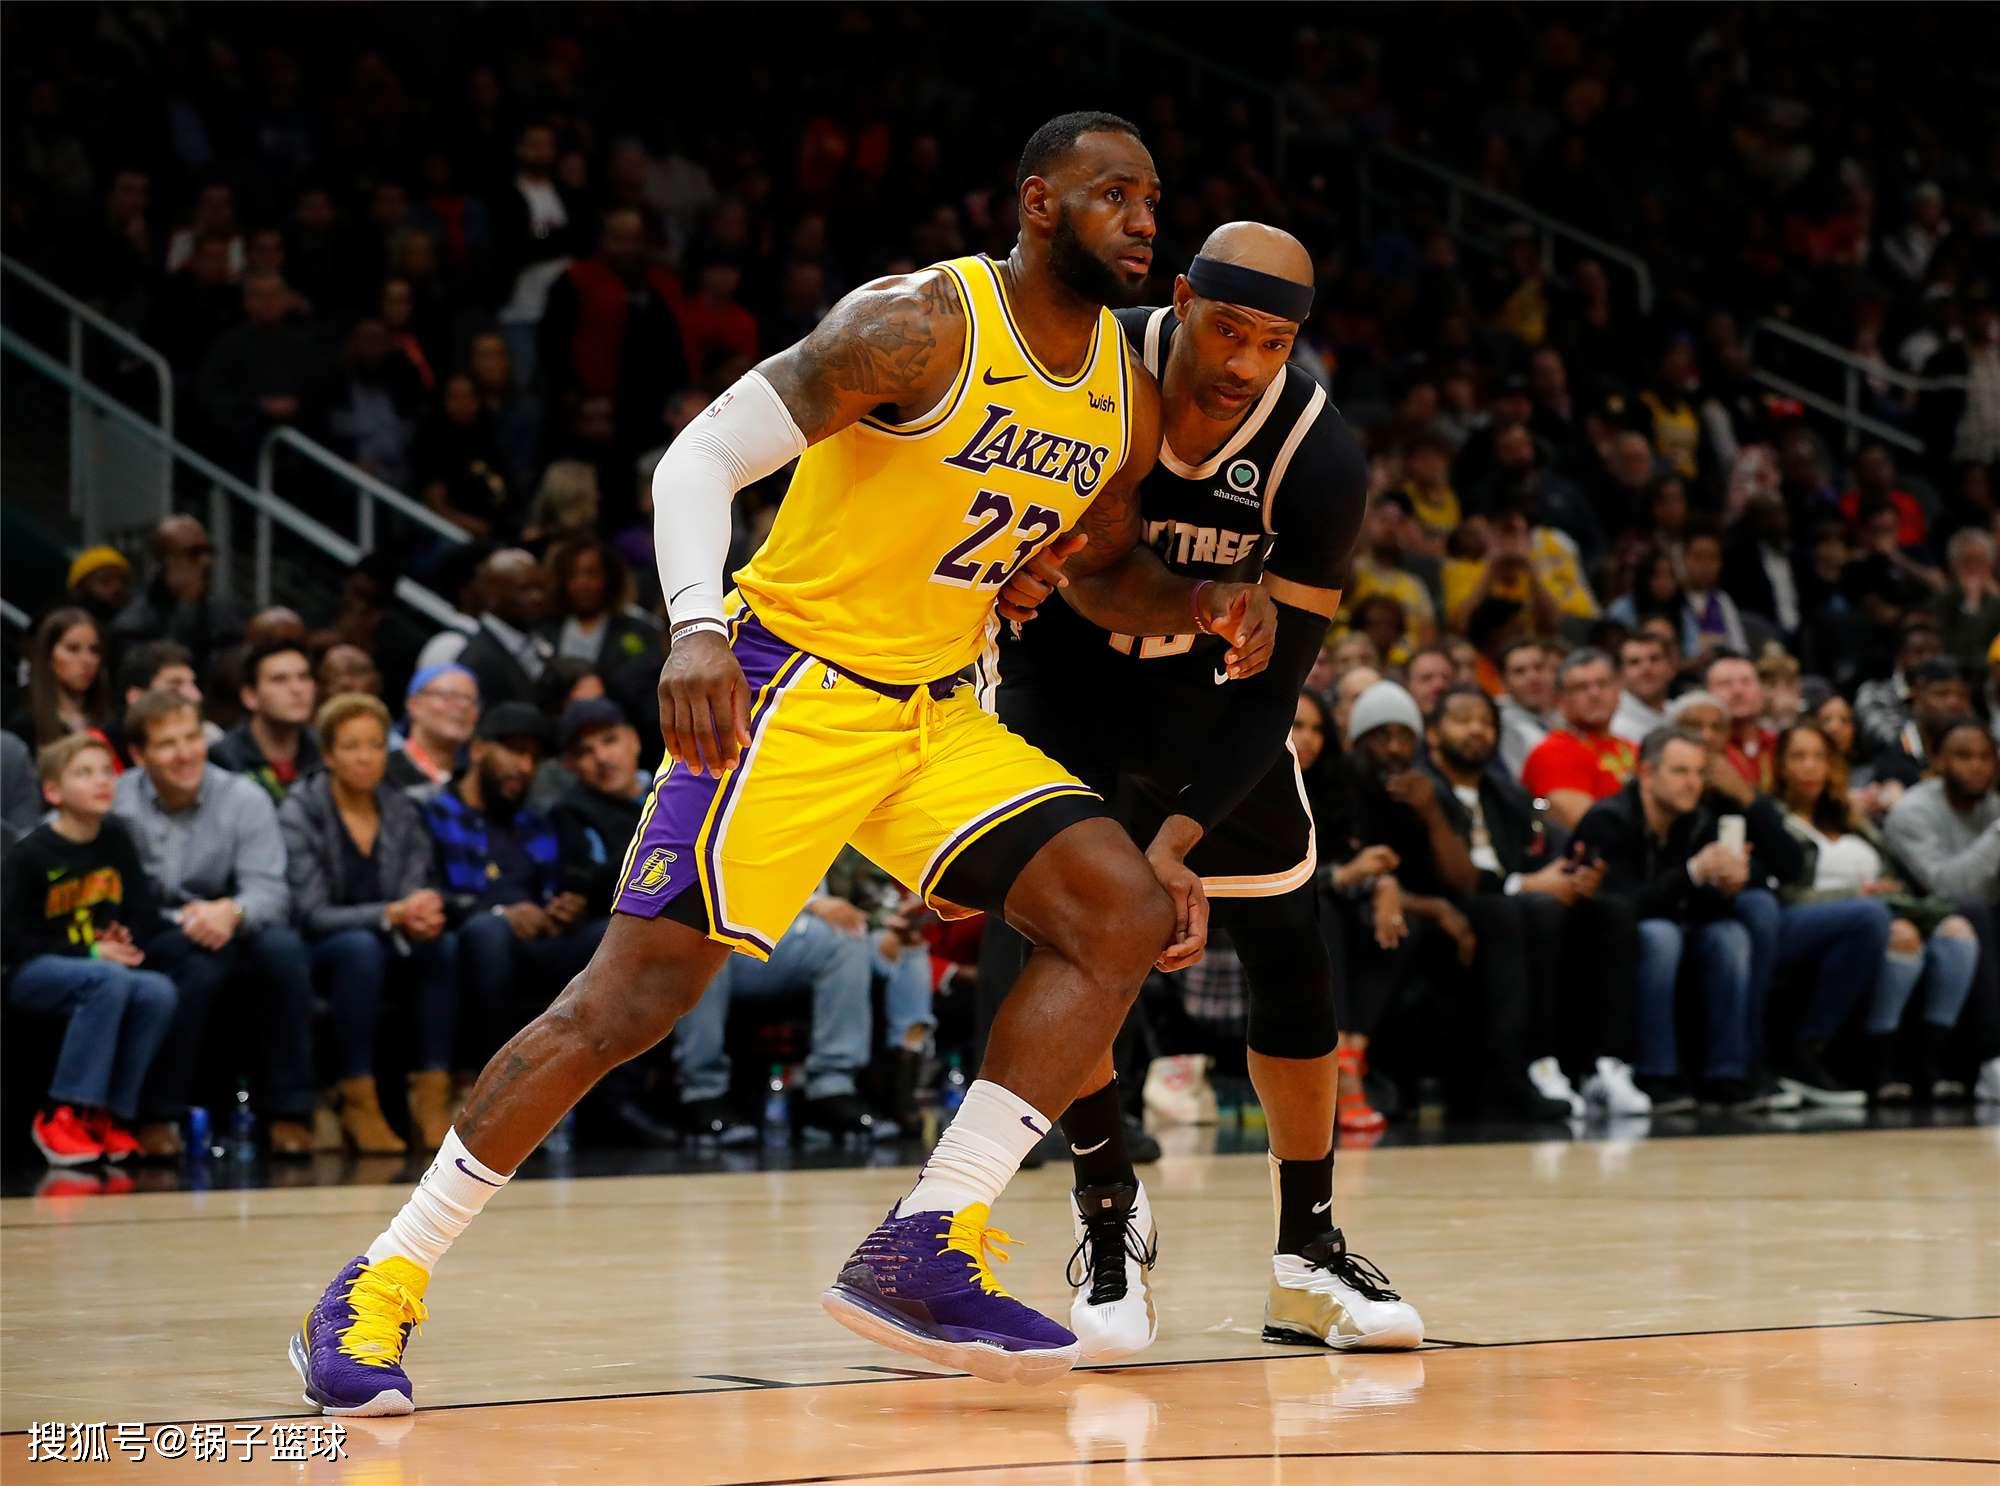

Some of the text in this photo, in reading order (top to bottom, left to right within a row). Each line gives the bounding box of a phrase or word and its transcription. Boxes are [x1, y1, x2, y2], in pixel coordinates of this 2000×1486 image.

[1088, 390, 1115, 413] wish
[941, 403, 1111, 498] LAKERS
[1213, 489, 1260, 508] sharecare
[928, 488, 1061, 591] 23
[1149, 519, 1261, 565] TREE
